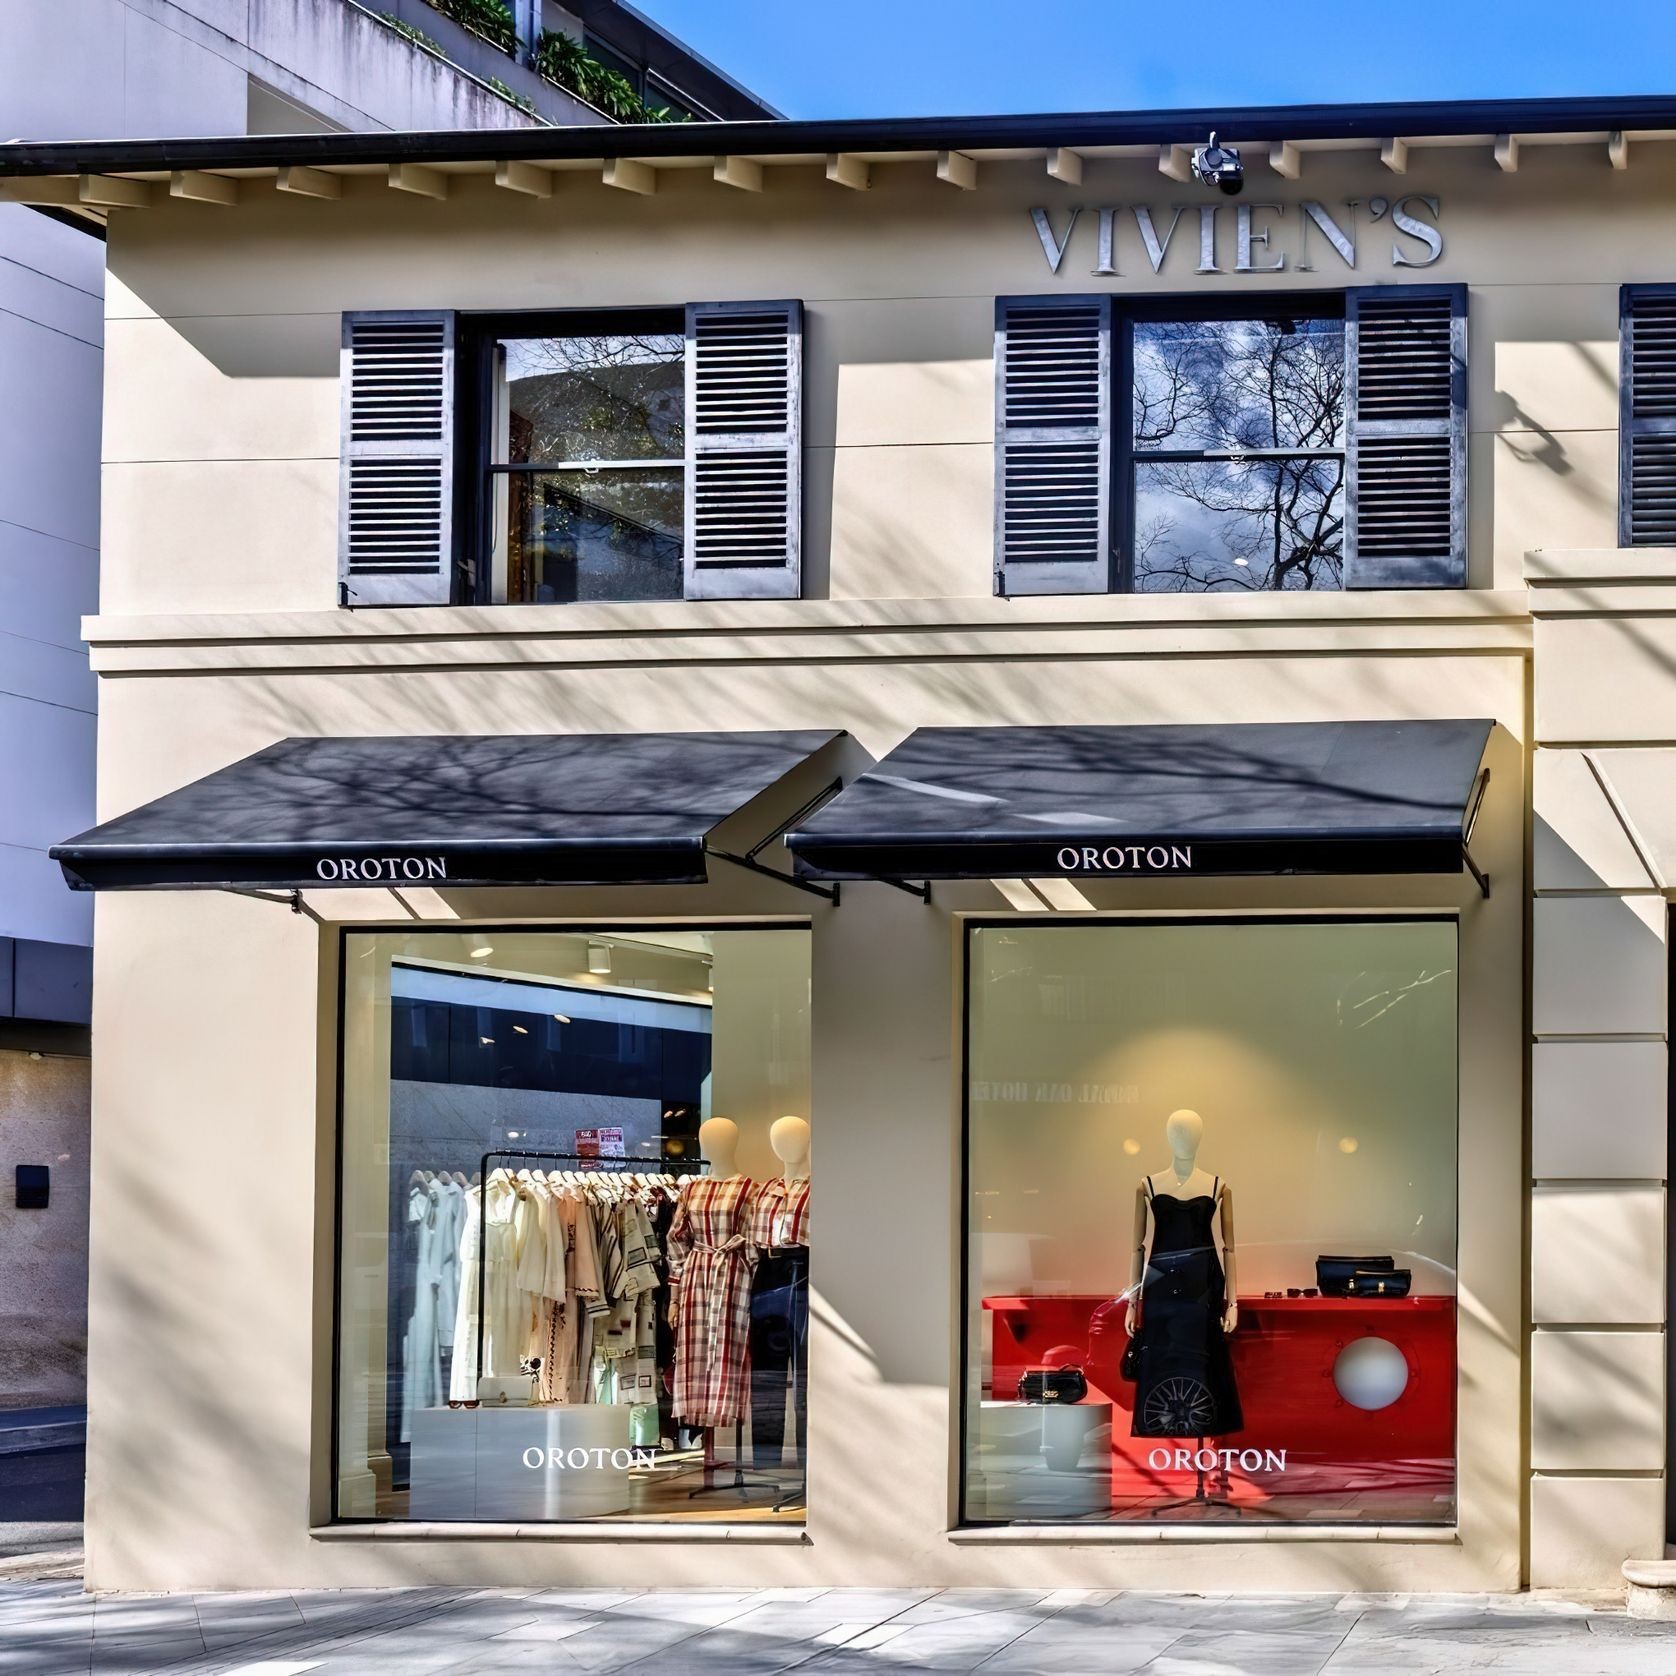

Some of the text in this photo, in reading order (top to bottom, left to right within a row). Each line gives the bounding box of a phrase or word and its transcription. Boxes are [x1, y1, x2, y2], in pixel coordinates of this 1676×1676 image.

[1028, 195, 1444, 277] VIVIEN'S
[316, 857, 448, 880] OROTON
[1057, 846, 1193, 870] OROTON
[522, 1446, 657, 1470] OROTON
[1148, 1447, 1288, 1472] OROTON
